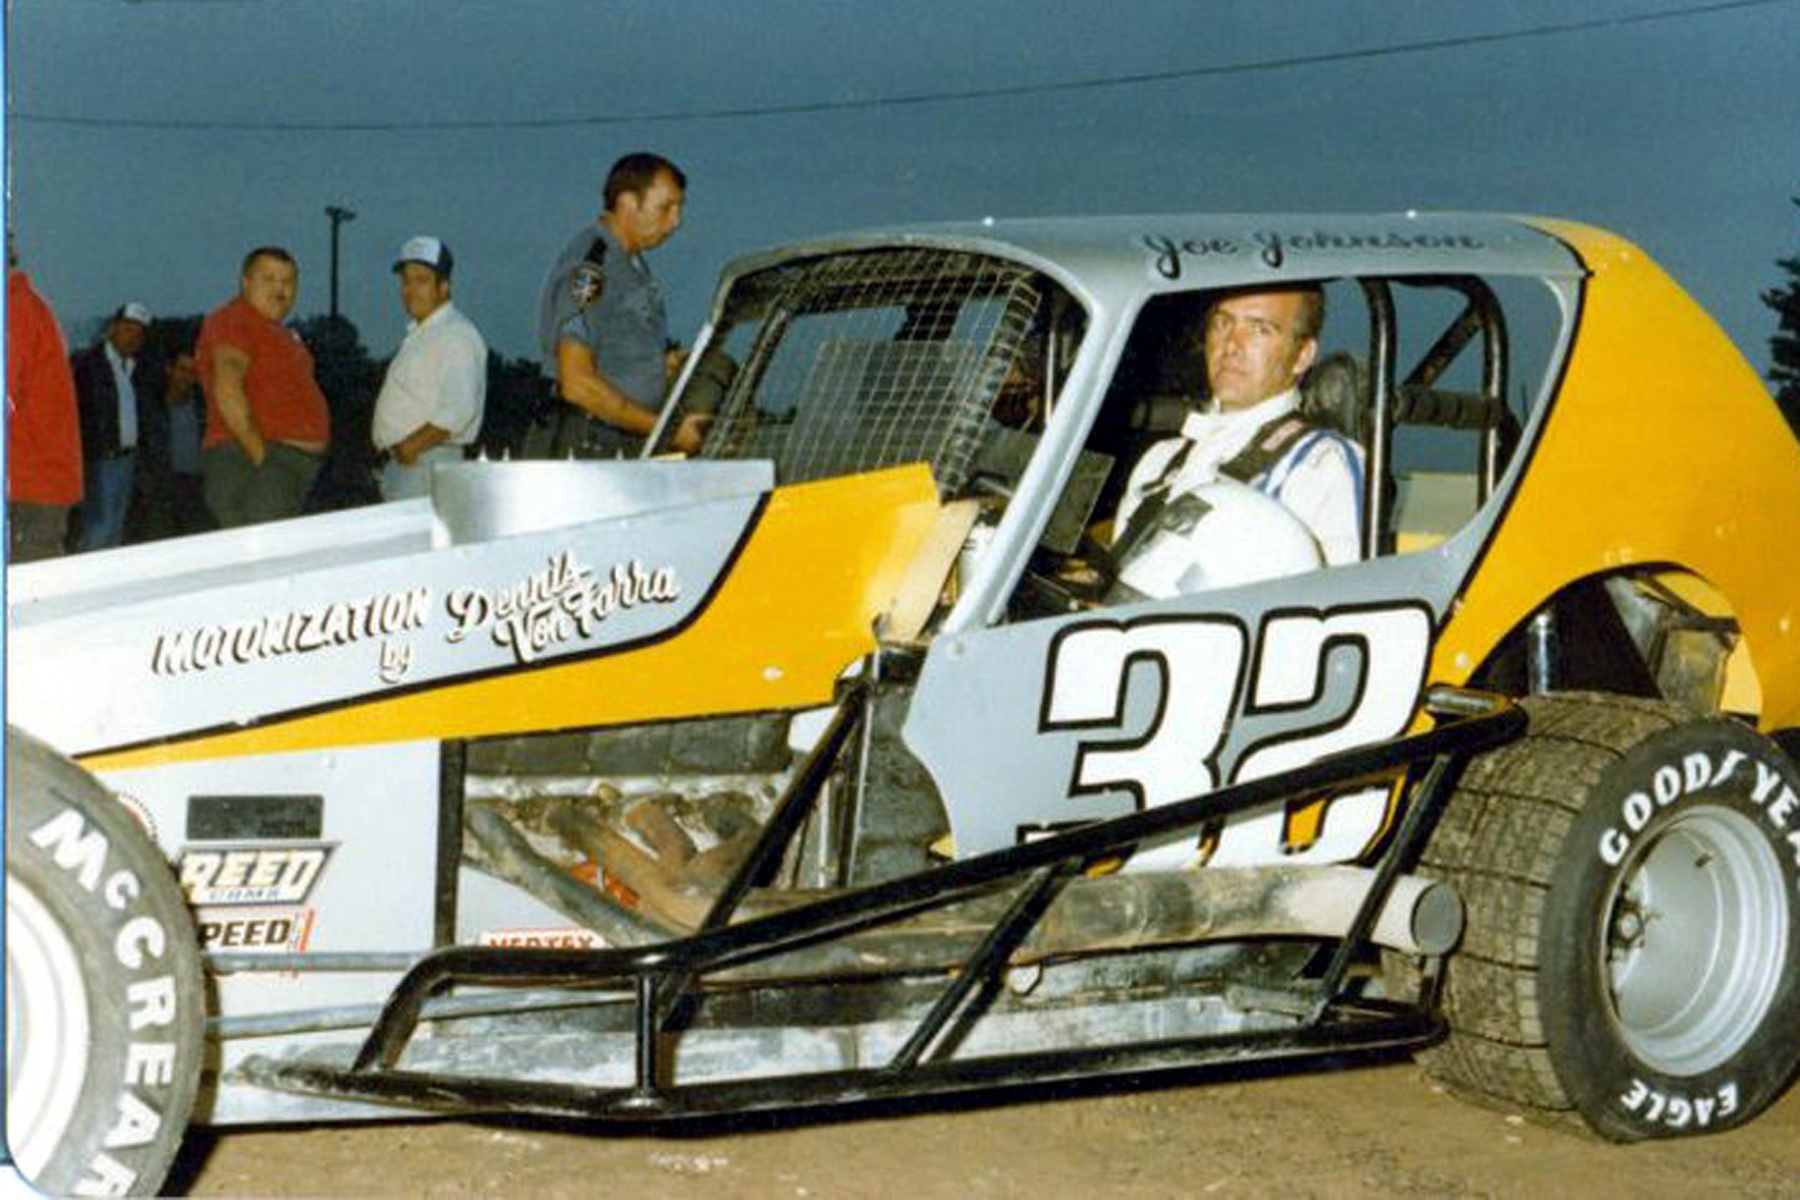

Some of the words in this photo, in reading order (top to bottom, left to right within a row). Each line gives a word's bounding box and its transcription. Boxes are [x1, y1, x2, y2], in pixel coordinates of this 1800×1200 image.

[1143, 234, 1238, 280] Joe
[1252, 230, 1485, 268] Johnson
[1017, 599, 1436, 871] 32
[1600, 750, 1800, 892] GOODYE
[1621, 1079, 1738, 1128] EAGLE
